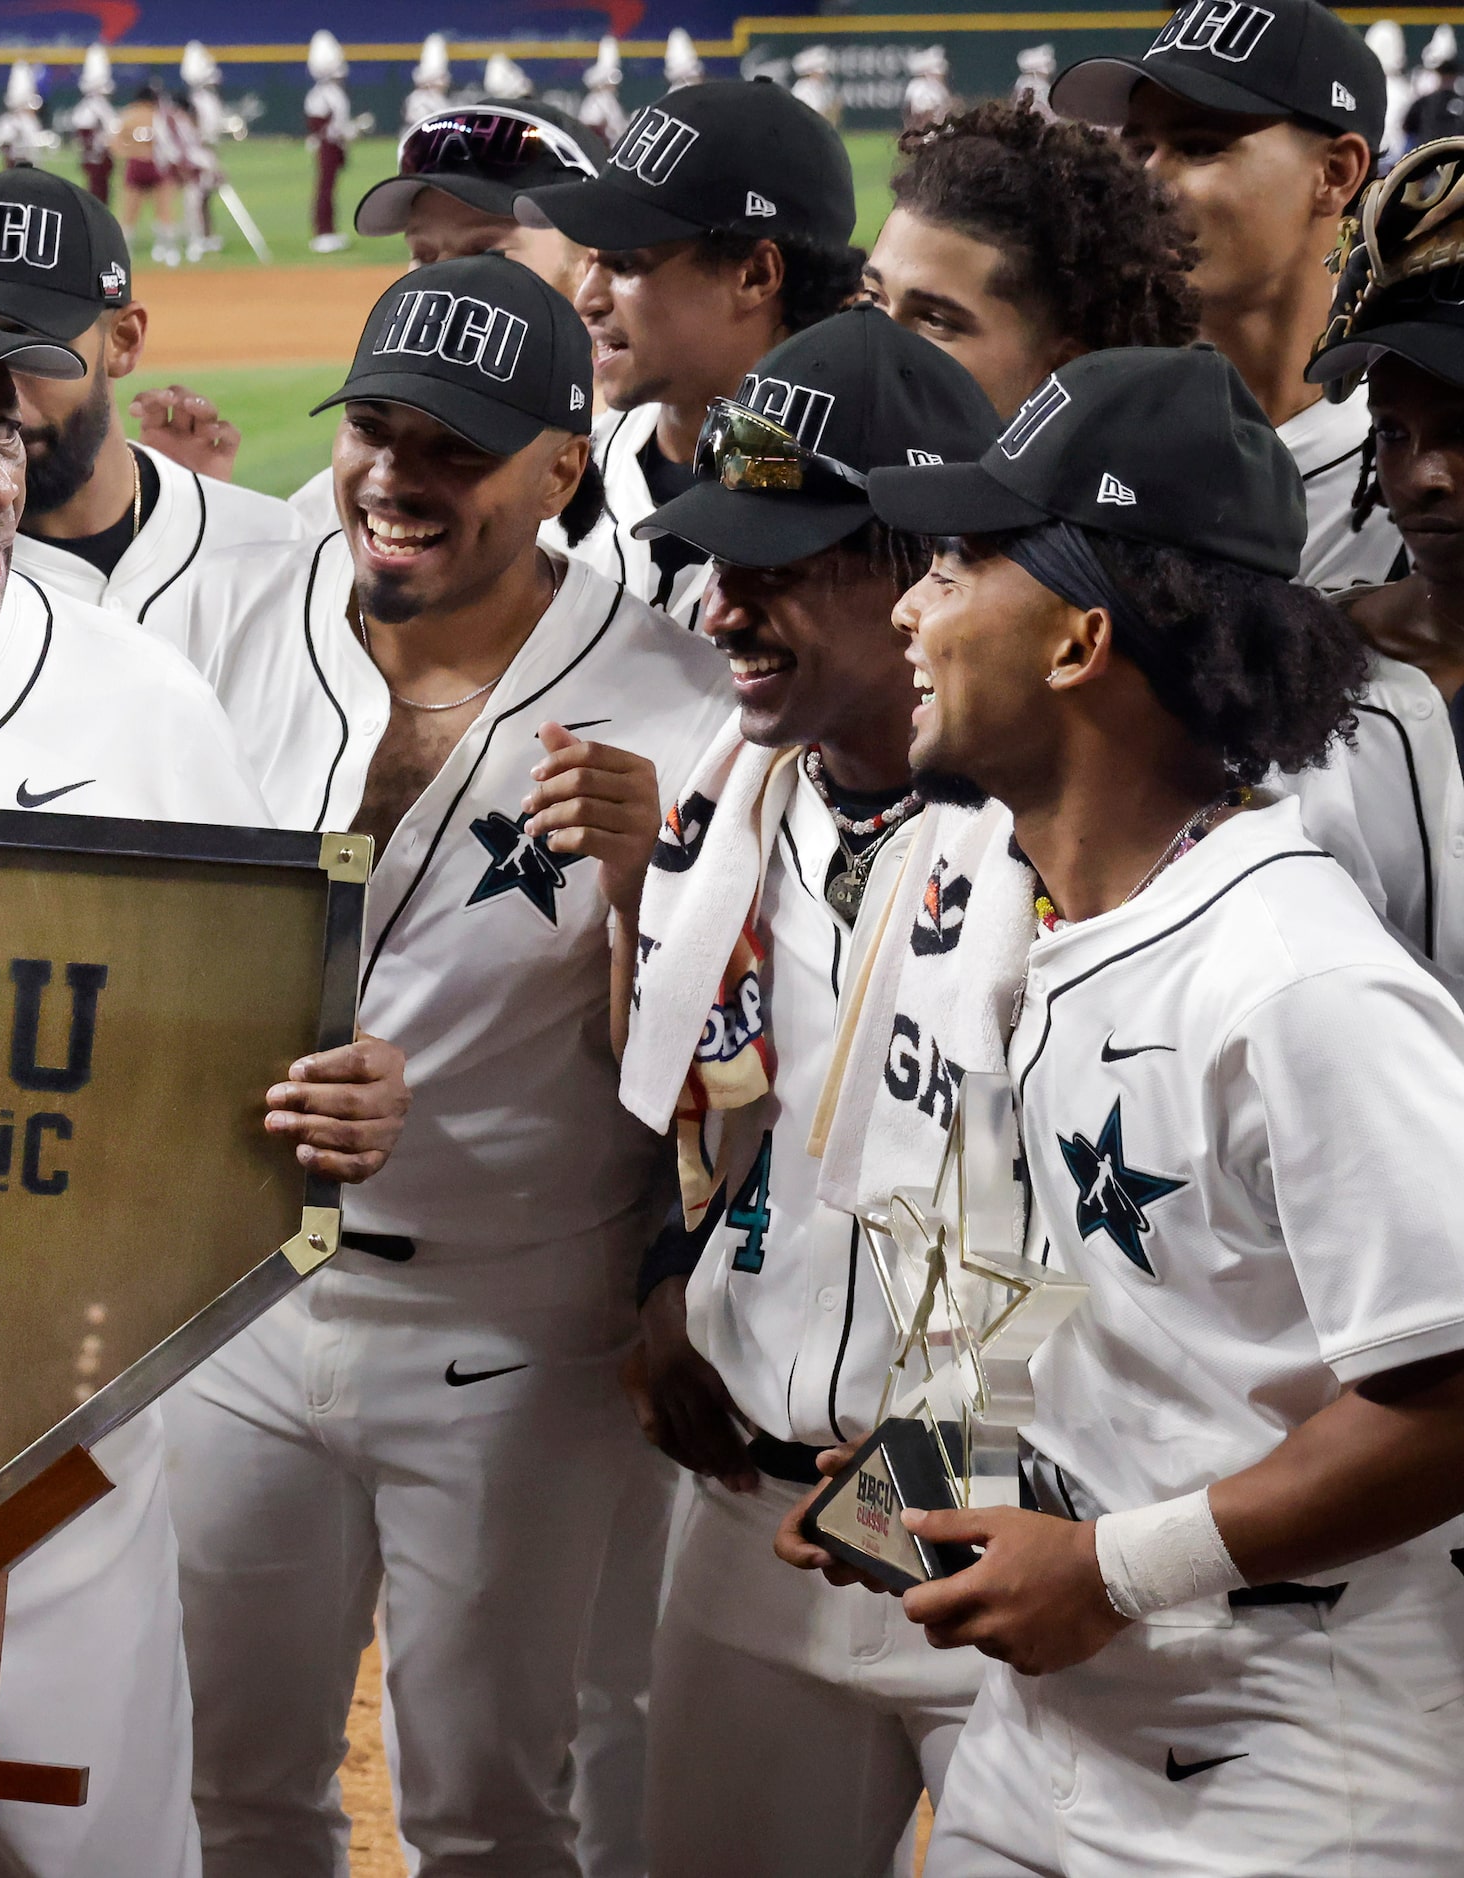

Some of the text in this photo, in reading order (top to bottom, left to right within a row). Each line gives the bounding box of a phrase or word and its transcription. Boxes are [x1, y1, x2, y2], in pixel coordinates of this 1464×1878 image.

[372, 290, 529, 381] HBCU
[726, 1130, 772, 1274] 4
[856, 1469, 894, 1516] HBCU
